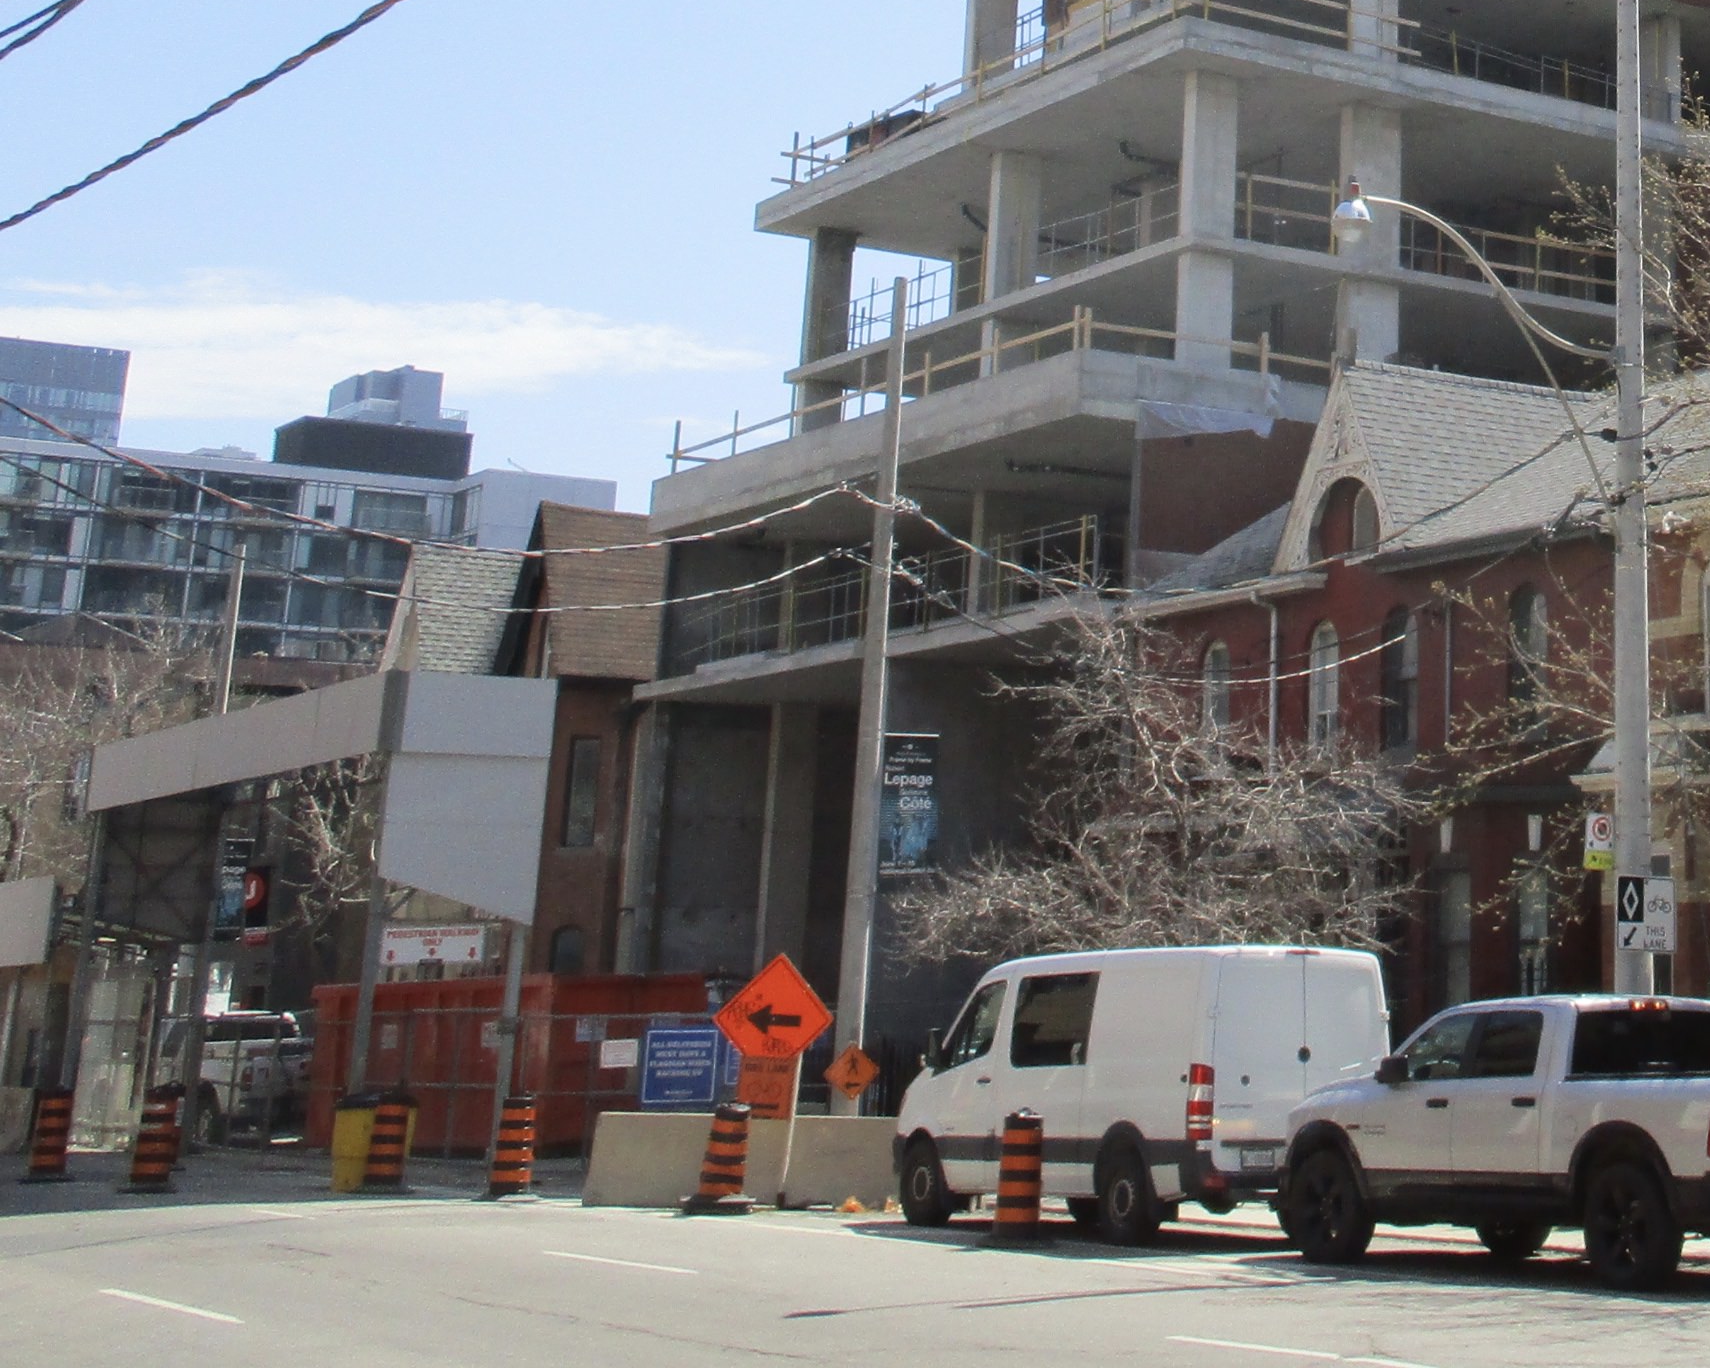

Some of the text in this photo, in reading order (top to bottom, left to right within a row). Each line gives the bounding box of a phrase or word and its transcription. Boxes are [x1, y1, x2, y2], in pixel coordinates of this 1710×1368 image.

[884, 772, 933, 788] Lepage
[900, 795, 932, 810] Côté
[1645, 926, 1666, 937] THIS
[1643, 939, 1667, 950] LANE
